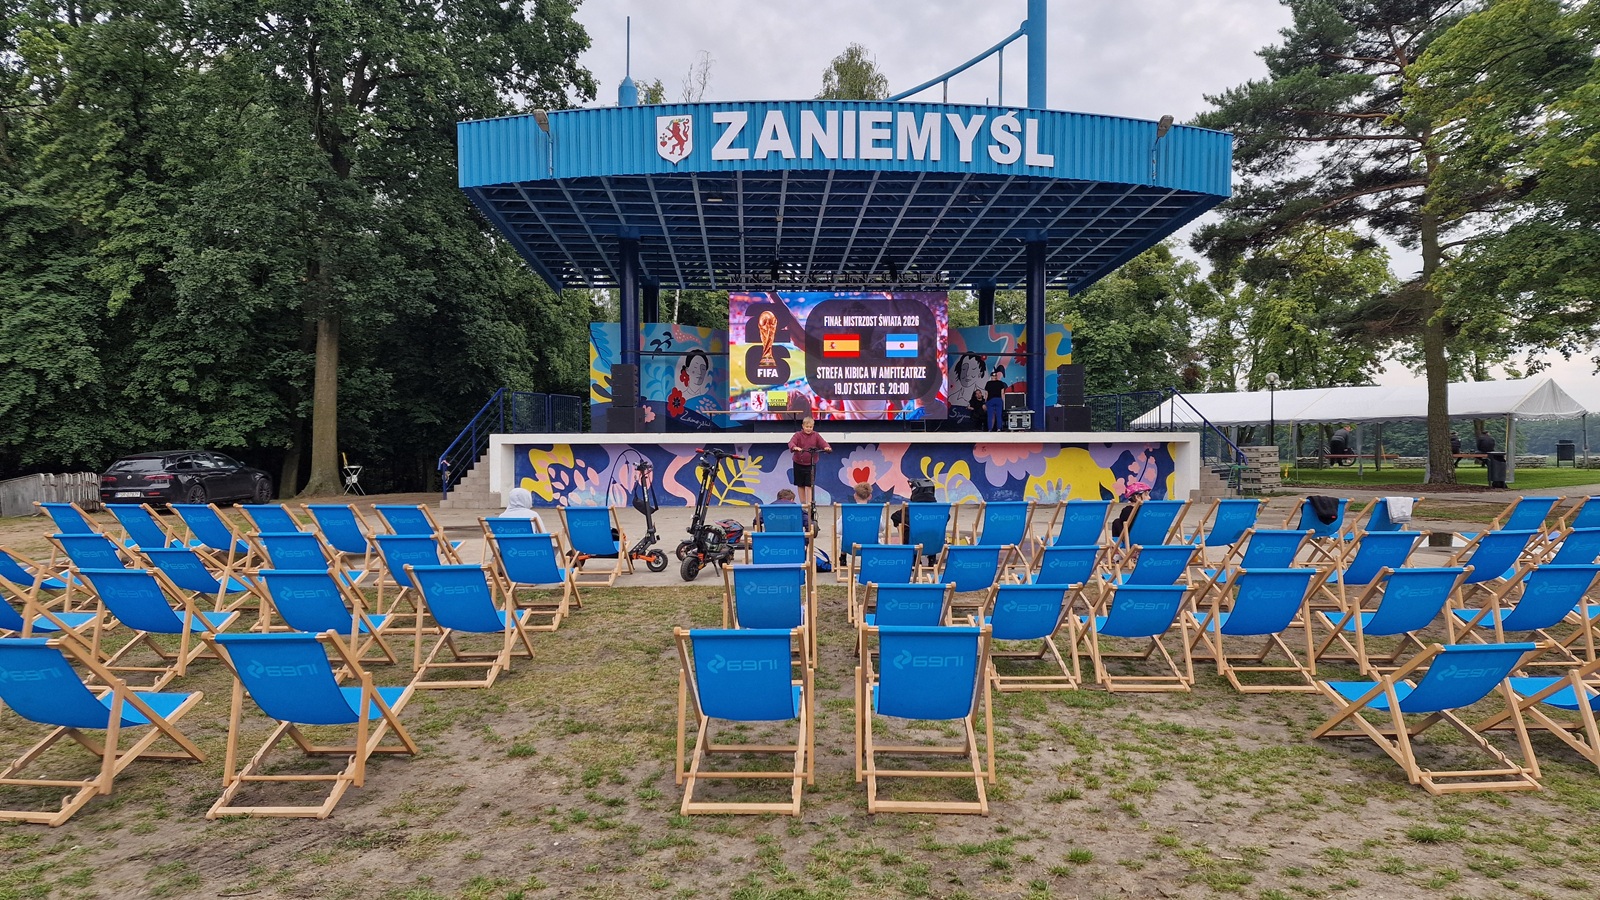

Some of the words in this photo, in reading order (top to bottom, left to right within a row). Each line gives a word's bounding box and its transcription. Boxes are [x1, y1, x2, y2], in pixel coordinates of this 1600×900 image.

[711, 110, 1055, 168] ZANIEMYŚL
[824, 316, 842, 326] FINAŁ
[843, 316, 877, 326] MISTRZOST
[879, 314, 901, 326] ŚWIATA
[903, 316, 919, 326] 2026
[757, 369, 778, 377] FIFA
[817, 367, 843, 378] STREFA
[845, 367, 869, 378] KIBICA
[870, 367, 877, 378] W
[879, 367, 926, 378] AMFITEATRZE
[834, 383, 852, 394] 19.07
[854, 383, 878, 394] START:
[880, 383, 887, 394] G.
[888, 383, 909, 394] 20:00
